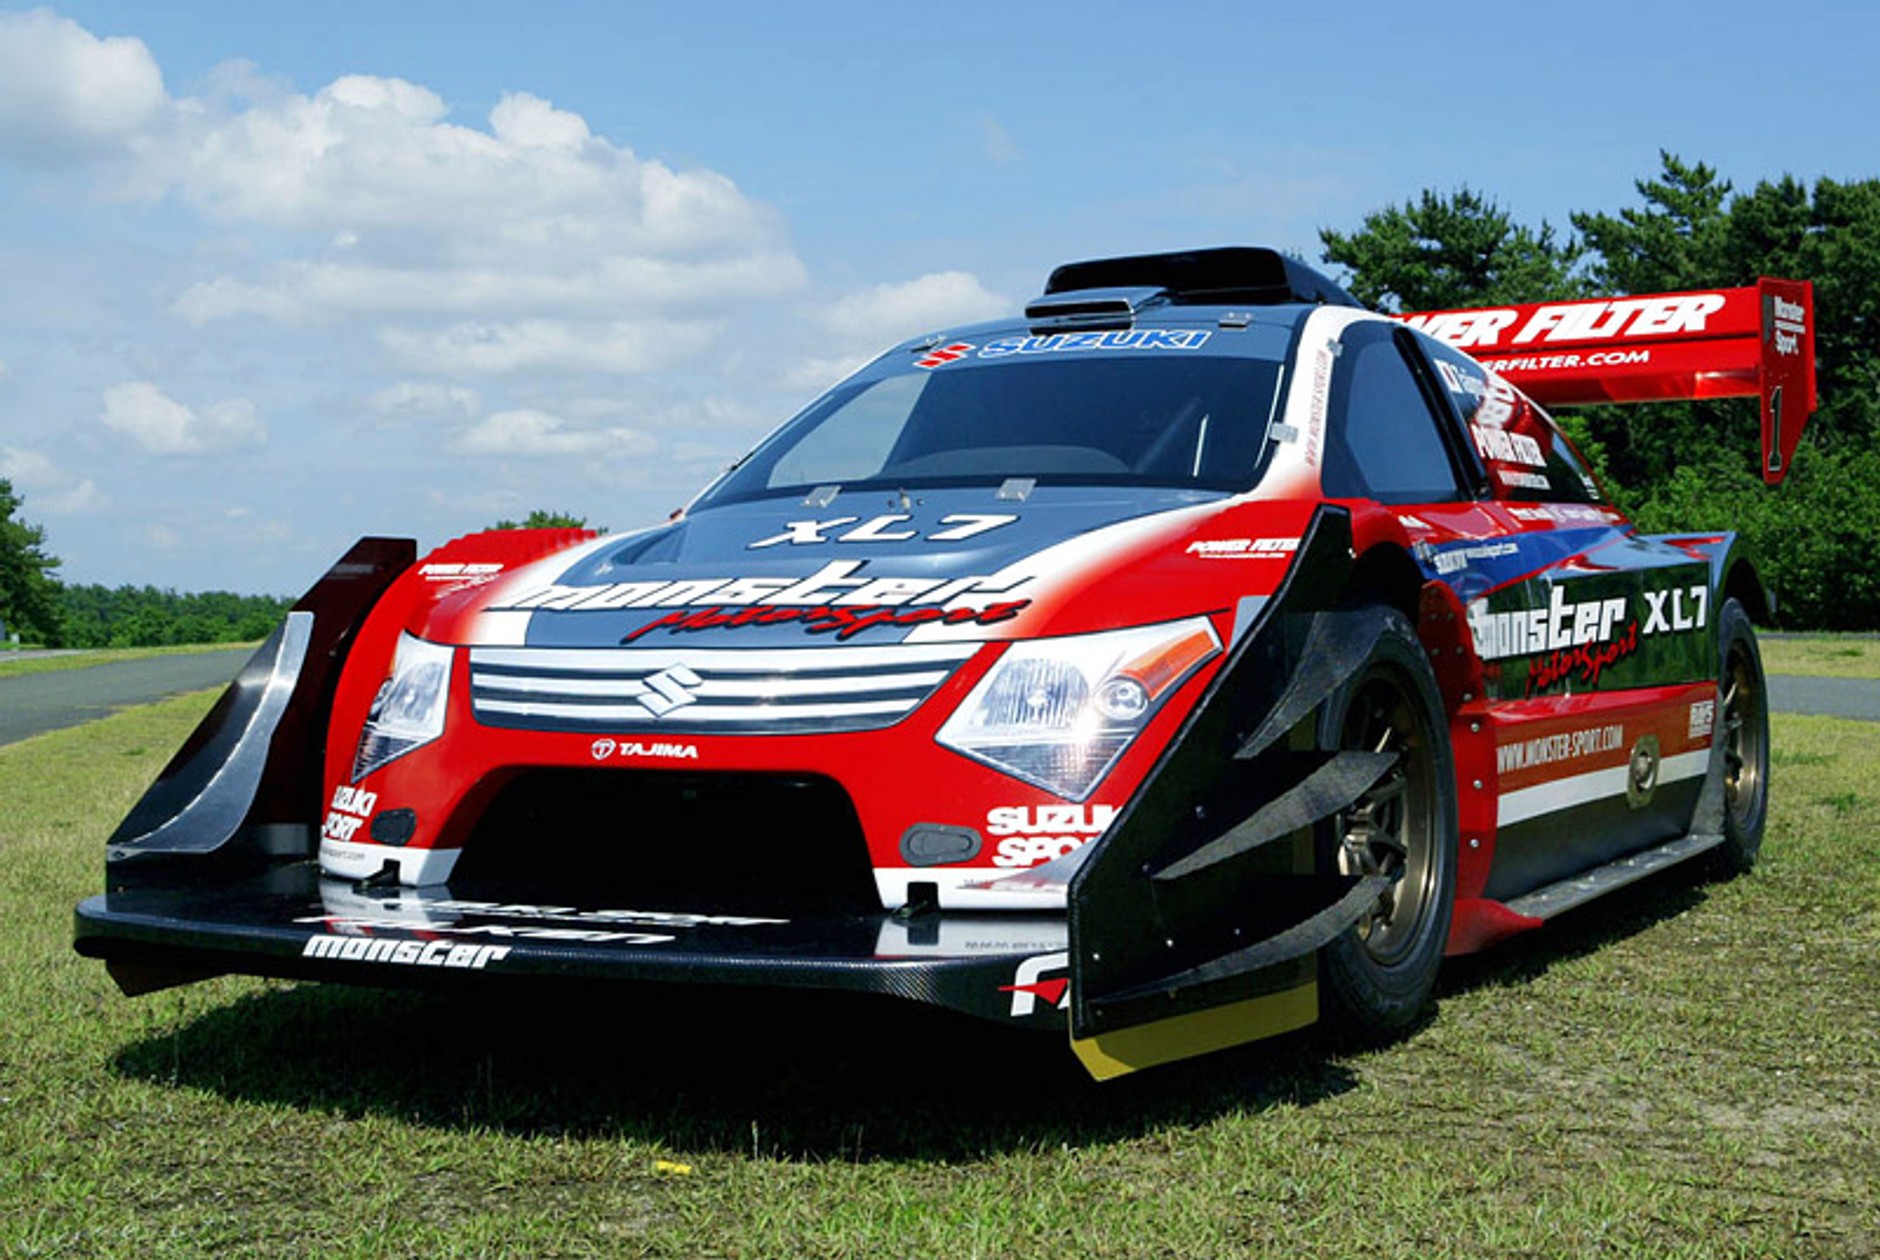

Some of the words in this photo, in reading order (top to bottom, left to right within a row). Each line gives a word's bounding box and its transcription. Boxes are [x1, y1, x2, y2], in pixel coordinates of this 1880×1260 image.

[1511, 294, 1725, 344] FILTER
[977, 329, 1213, 359] SUZUKI
[746, 512, 1022, 549] XL7
[1642, 585, 1708, 634] XL7
[619, 742, 699, 759] TAJIMA
